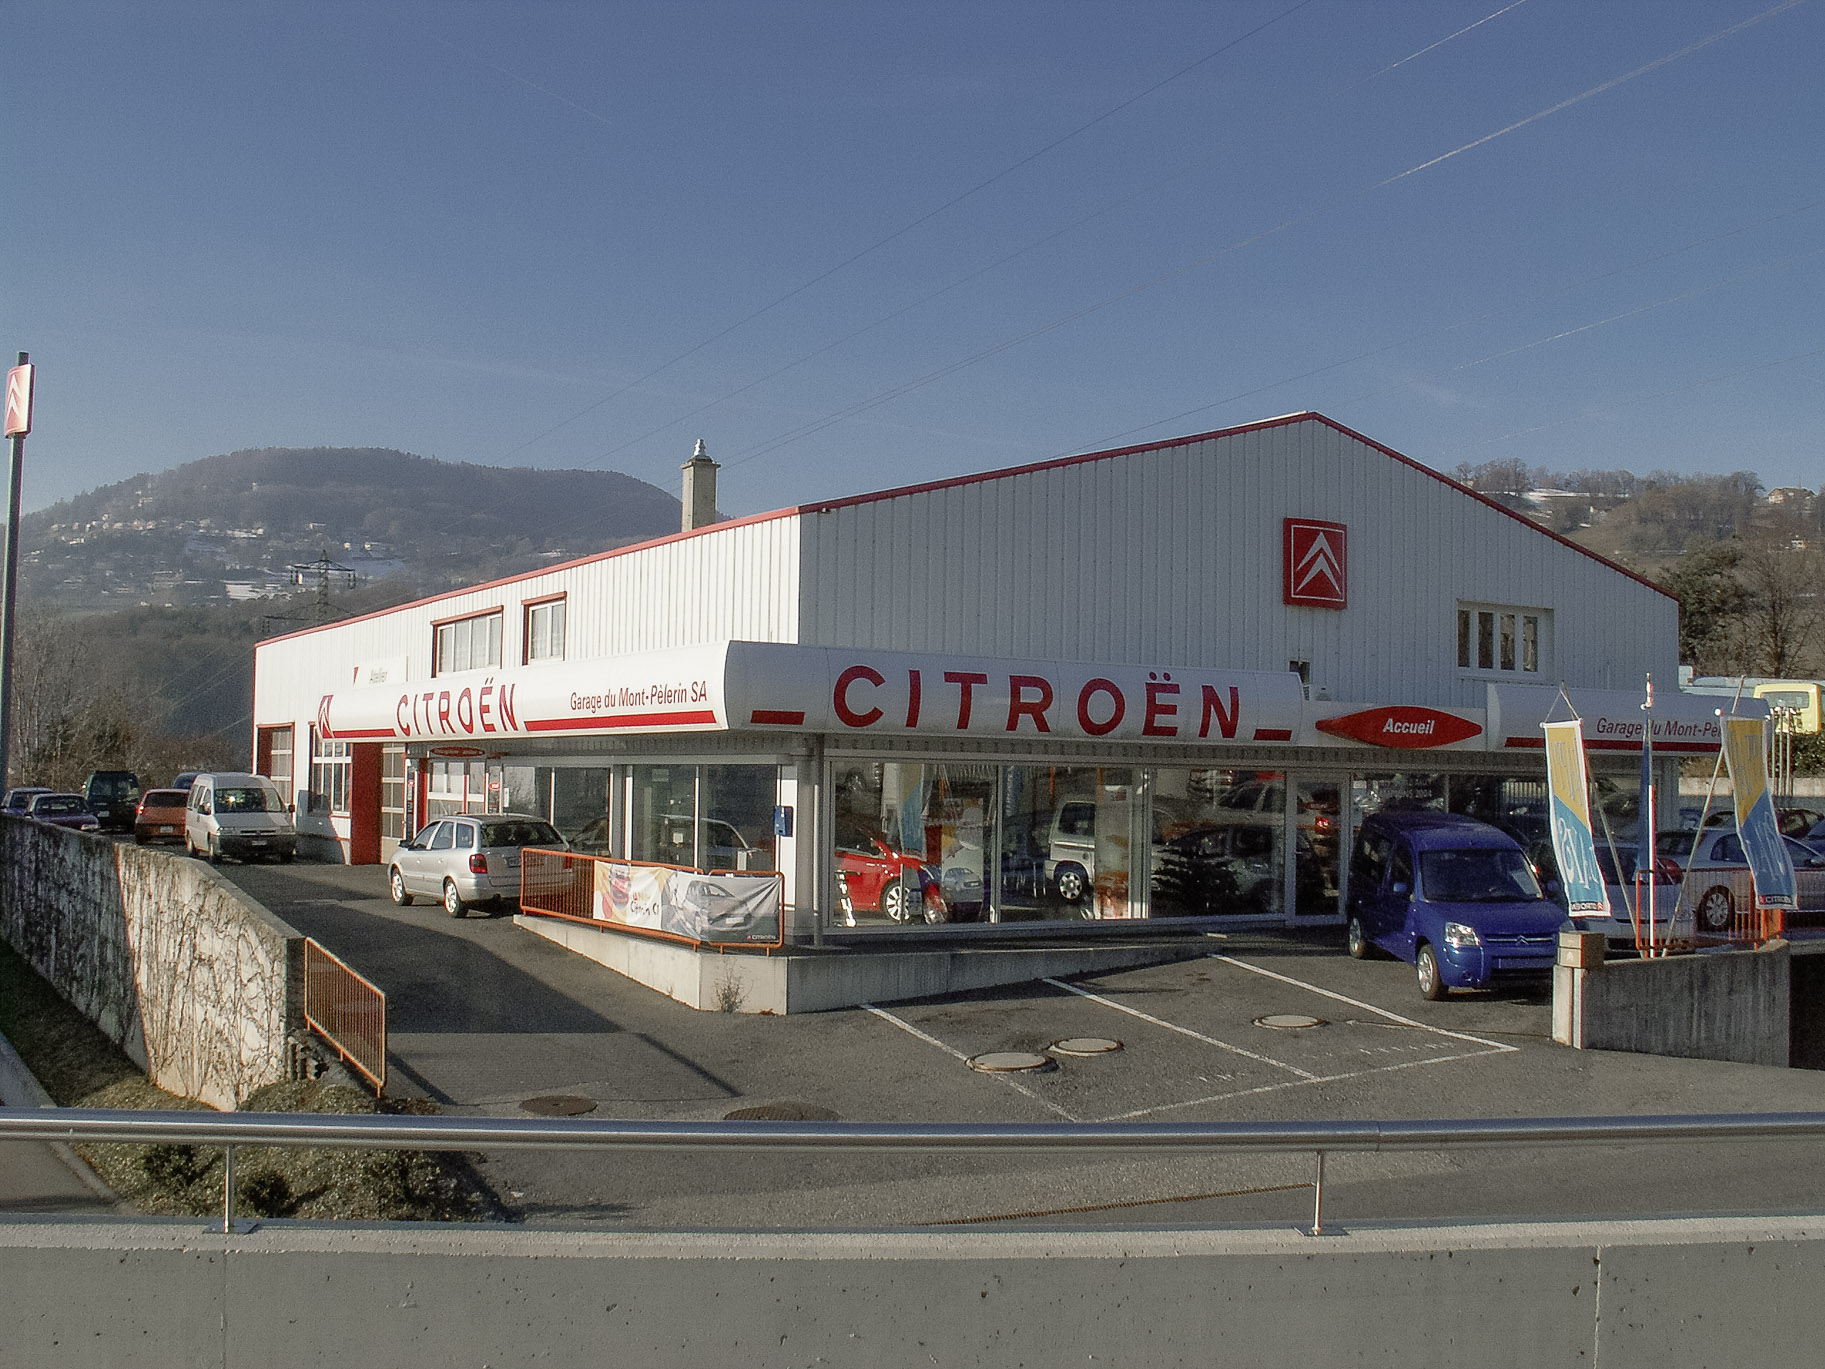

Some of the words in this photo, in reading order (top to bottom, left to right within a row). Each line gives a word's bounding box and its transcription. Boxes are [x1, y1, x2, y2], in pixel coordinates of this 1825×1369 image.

[396, 676, 519, 736] CITROËN
[570, 691, 602, 714] Garage
[604, 688, 616, 709] du
[618, 682, 688, 707] Mont-Pèlerin
[690, 680, 707, 703] SA
[832, 665, 1241, 738] CITROËN
[1382, 717, 1436, 735] Accueil
[1596, 717, 1643, 739] Garage
